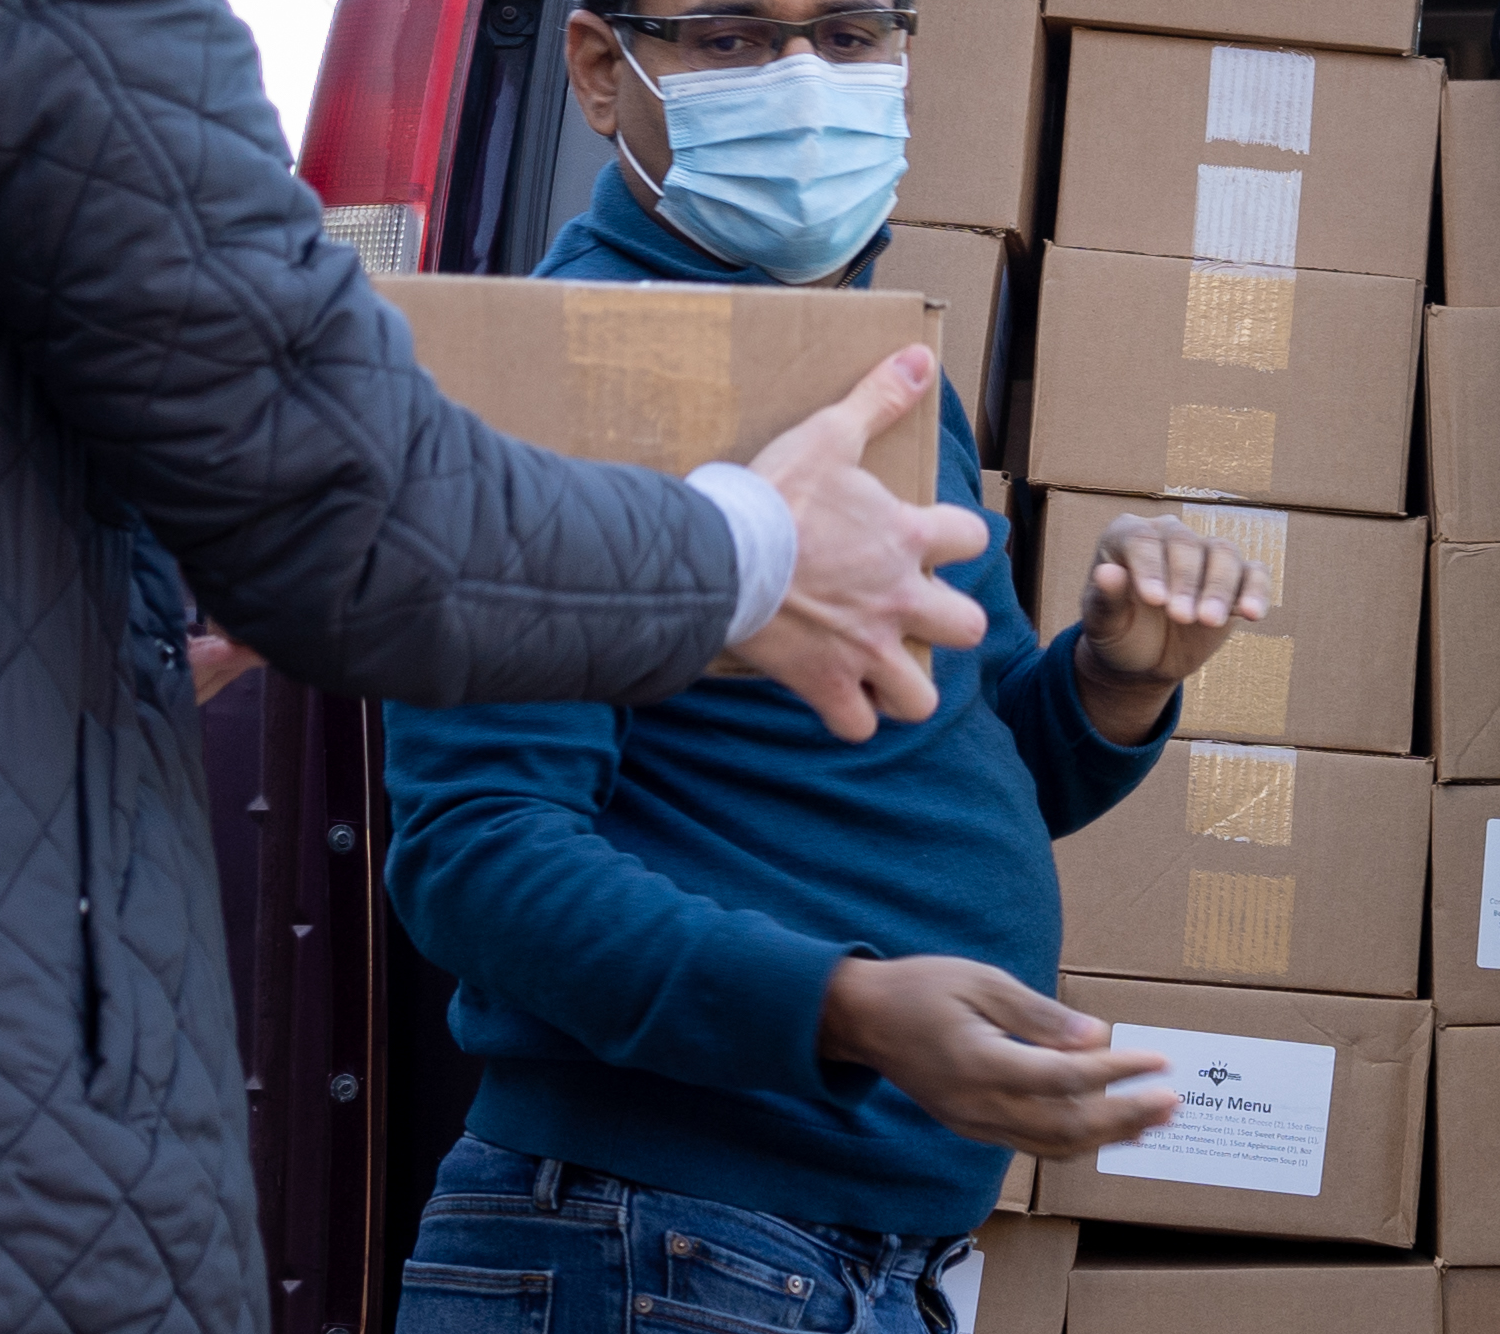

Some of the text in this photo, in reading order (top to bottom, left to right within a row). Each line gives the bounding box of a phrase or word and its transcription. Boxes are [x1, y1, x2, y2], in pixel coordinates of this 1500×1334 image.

[1175, 1091, 1272, 1113] oliday Menu
[1167, 1121, 1201, 1132] Cranberry
[1202, 1125, 1222, 1133] Sauce
[1255, 1131, 1275, 1139] Sweet
[1277, 1133, 1306, 1142] Potatoes
[1248, 1118, 1272, 1127] Cheese
[1185, 1135, 1215, 1144] Potatoes
[1248, 1142, 1285, 1152] Applesauce
[1186, 1147, 1208, 1155] 10.5oz
[1209, 1150, 1231, 1158] Cream
[1242, 1153, 1278, 1163] Mushroom
[1280, 1157, 1297, 1165] Soup
